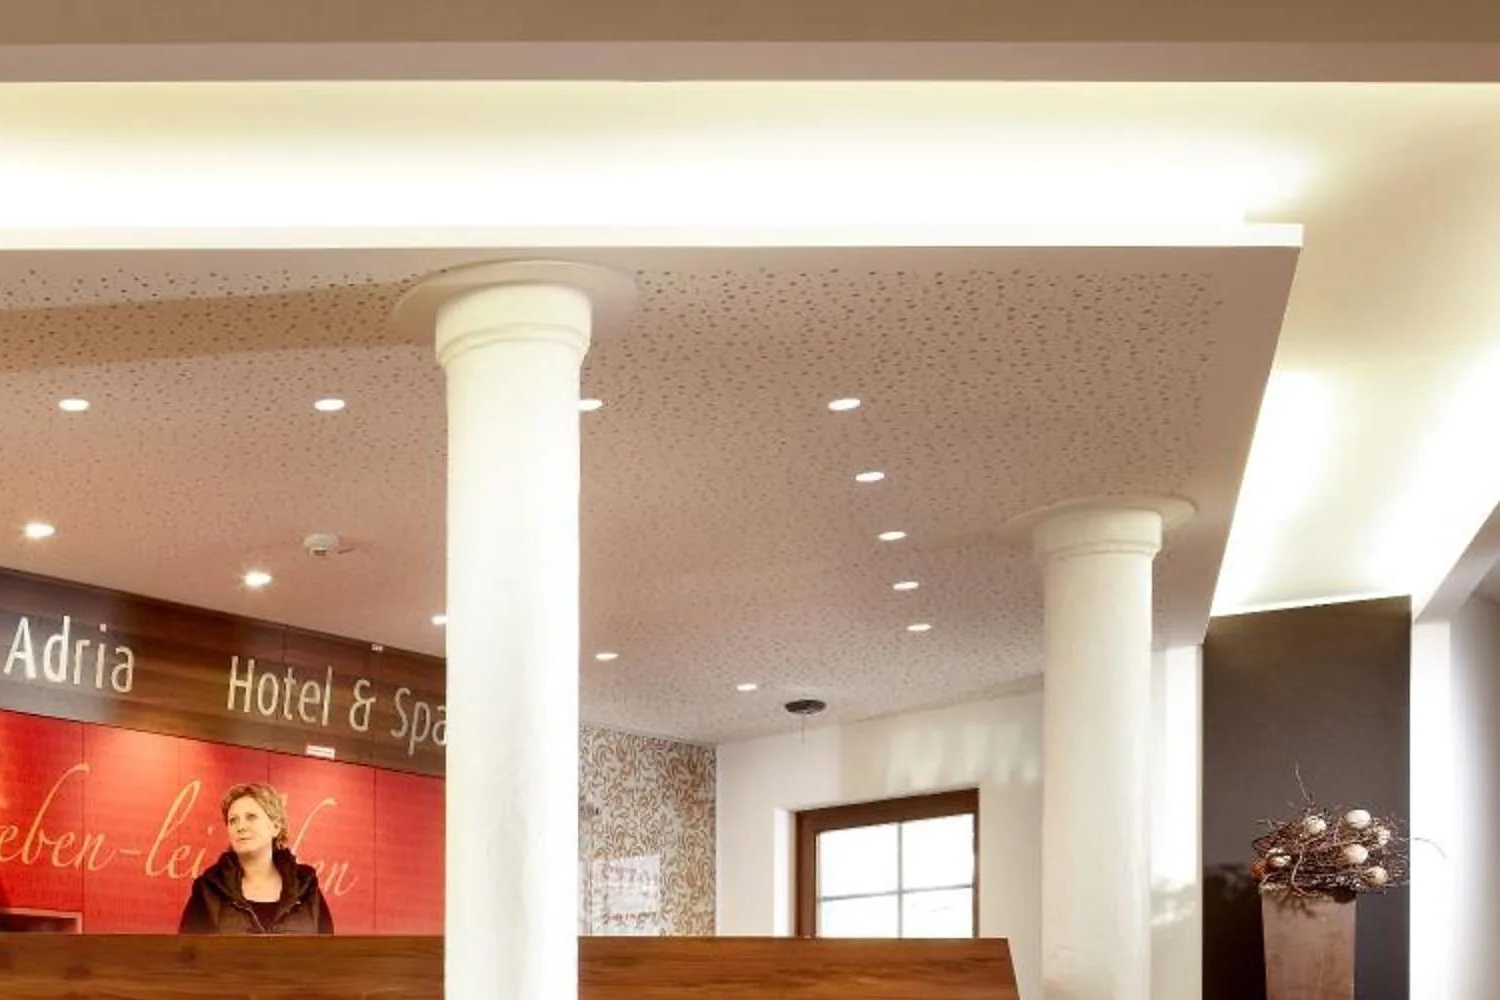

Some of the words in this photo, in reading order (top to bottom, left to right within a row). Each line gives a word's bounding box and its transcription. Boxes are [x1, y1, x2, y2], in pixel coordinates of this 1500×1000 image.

[3, 615, 135, 693] Adria
[227, 655, 333, 727] Hotel
[349, 679, 376, 732] &
[391, 687, 447, 757] Spa
